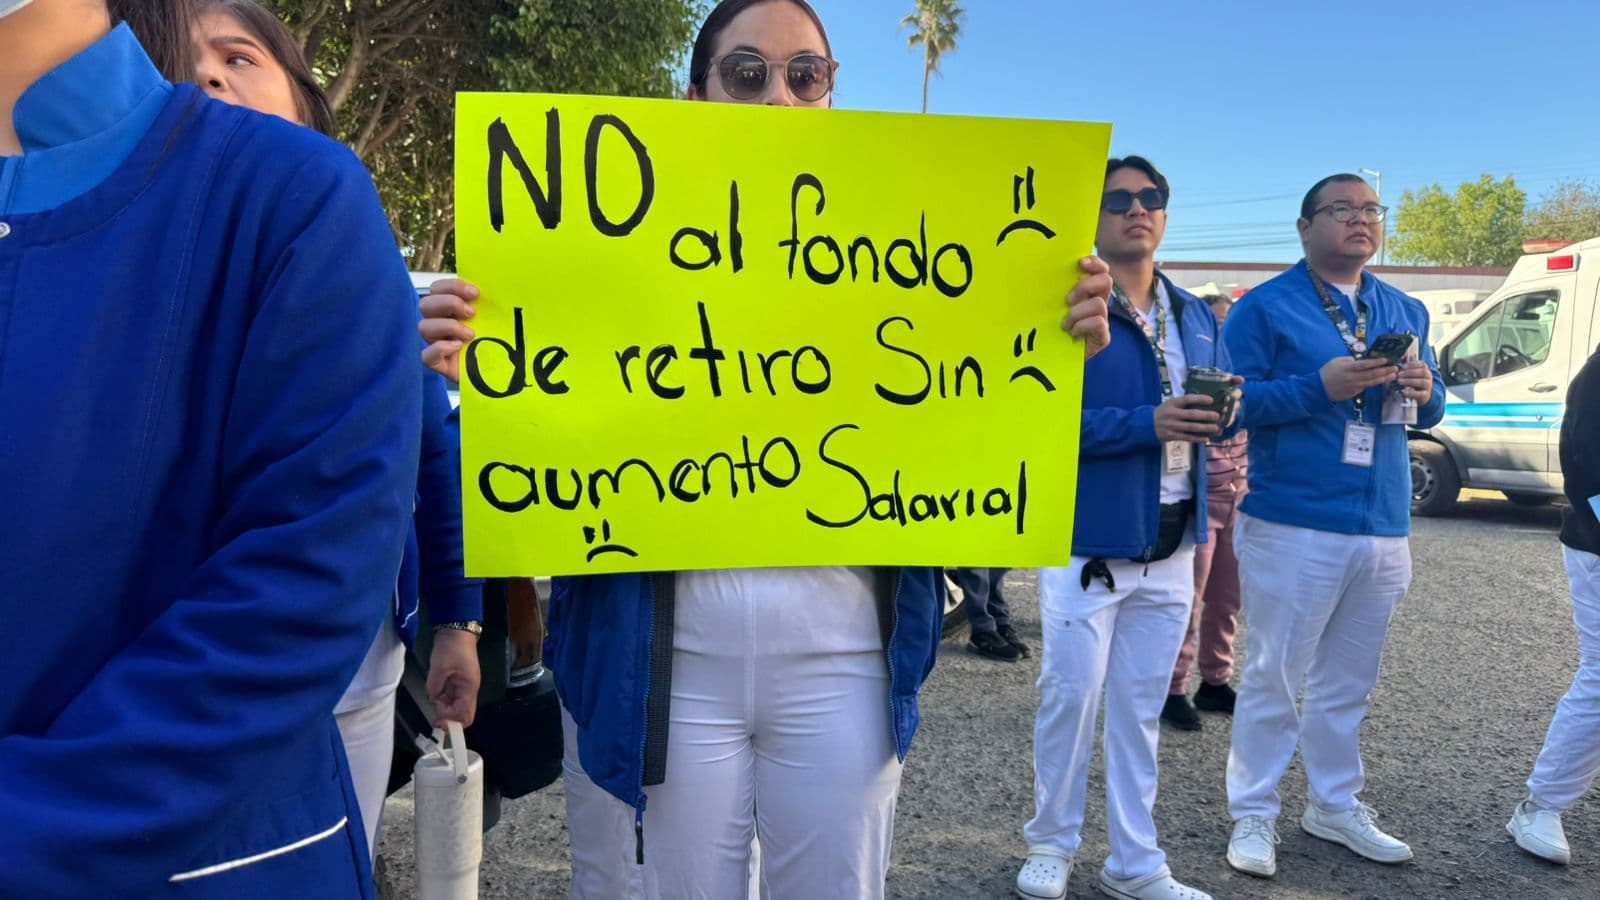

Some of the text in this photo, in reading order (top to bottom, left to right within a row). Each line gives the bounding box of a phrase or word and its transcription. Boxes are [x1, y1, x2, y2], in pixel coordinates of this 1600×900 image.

[487, 107, 973, 298] NO al fondo
[465, 301, 985, 406] de retiro Sin
[478, 423, 1027, 536] aumento Salarial
